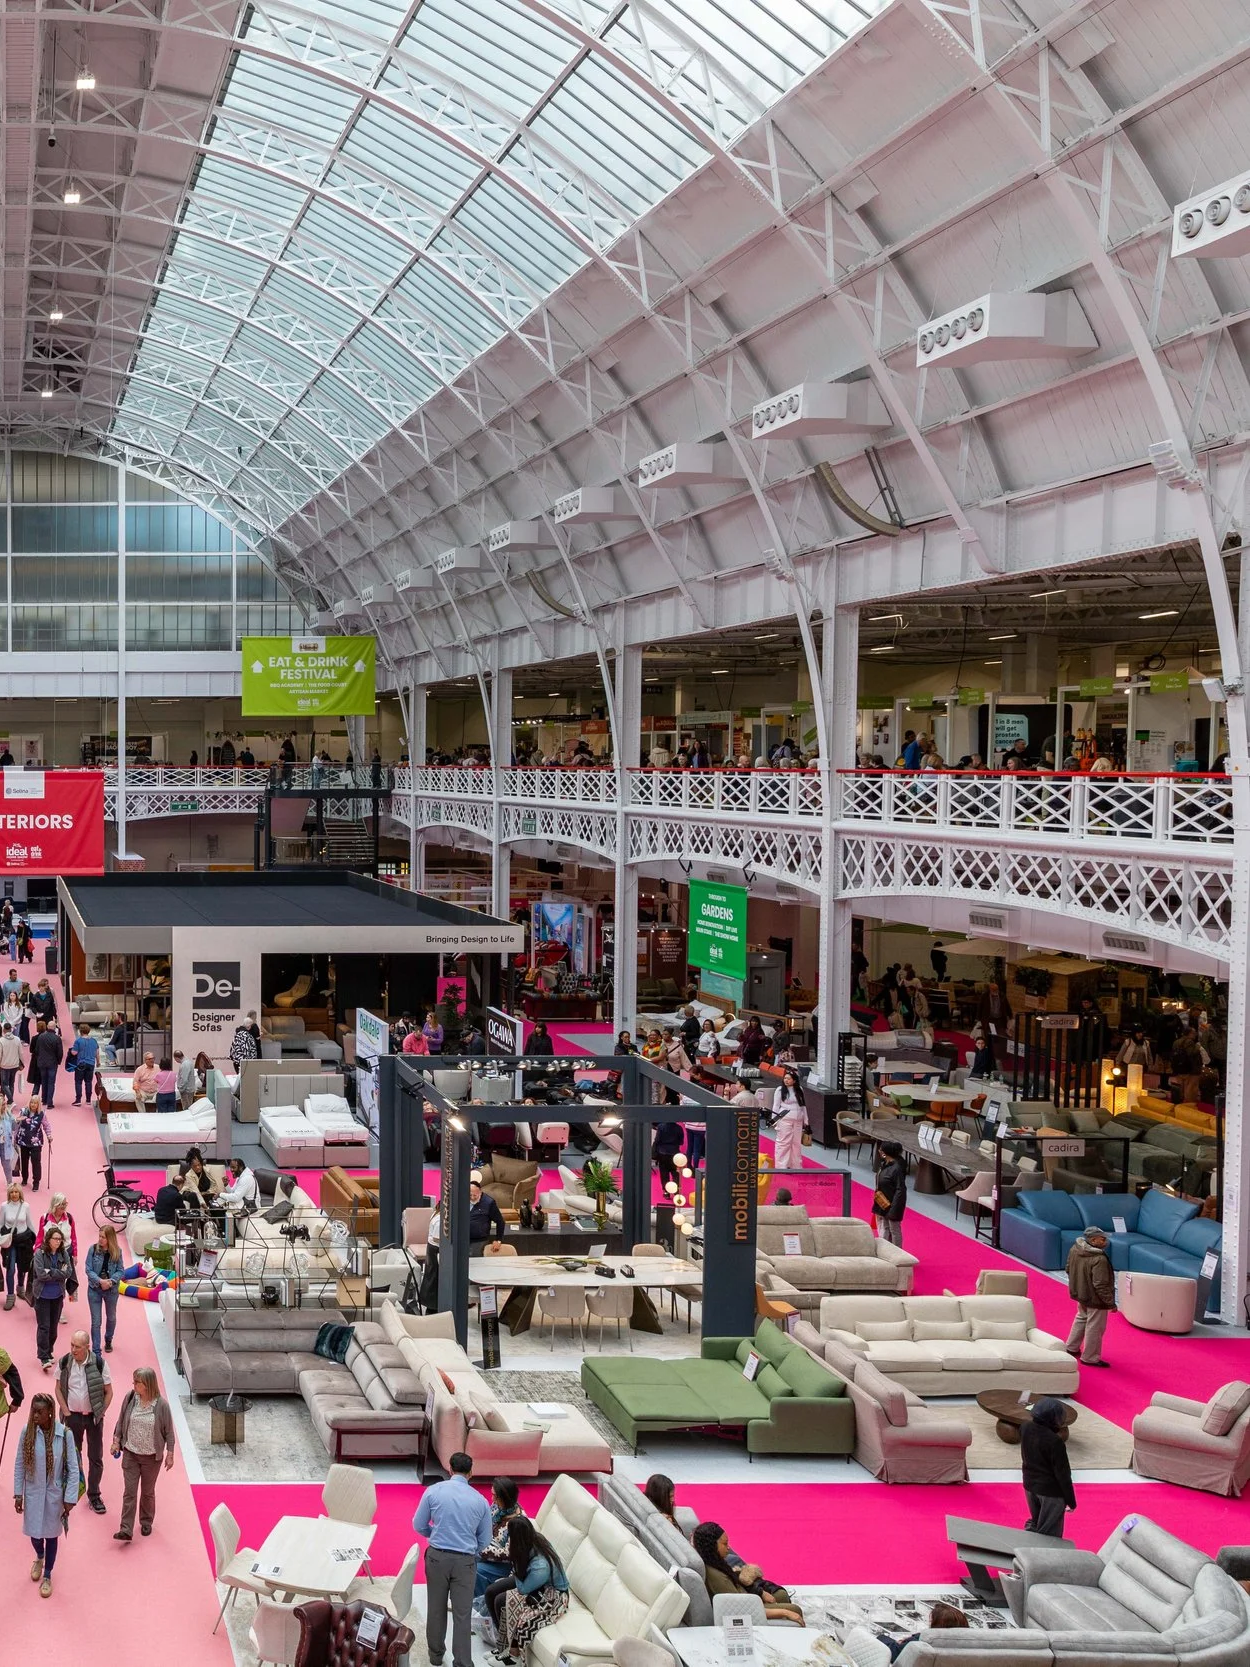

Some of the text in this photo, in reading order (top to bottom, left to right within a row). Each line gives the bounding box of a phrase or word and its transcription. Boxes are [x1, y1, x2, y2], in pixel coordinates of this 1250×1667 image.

[268, 657, 348, 667] EAT & DRINK
[280, 669, 337, 679] FESTIVAL
[6, 846, 28, 856] ideal
[701, 903, 733, 921] GARDENS
[426, 935, 458, 944] Bringing
[461, 935, 488, 944] Design
[192, 1013, 235, 1023] Designer
[192, 1023, 222, 1032] Sofas
[360, 1013, 380, 1040] Oakdale
[488, 1019, 513, 1046] OGAWA
[1048, 1142, 1079, 1152] cadira
[732, 1112, 750, 1240] mobilidomani
[485, 1319, 495, 1368] mobilidomani
